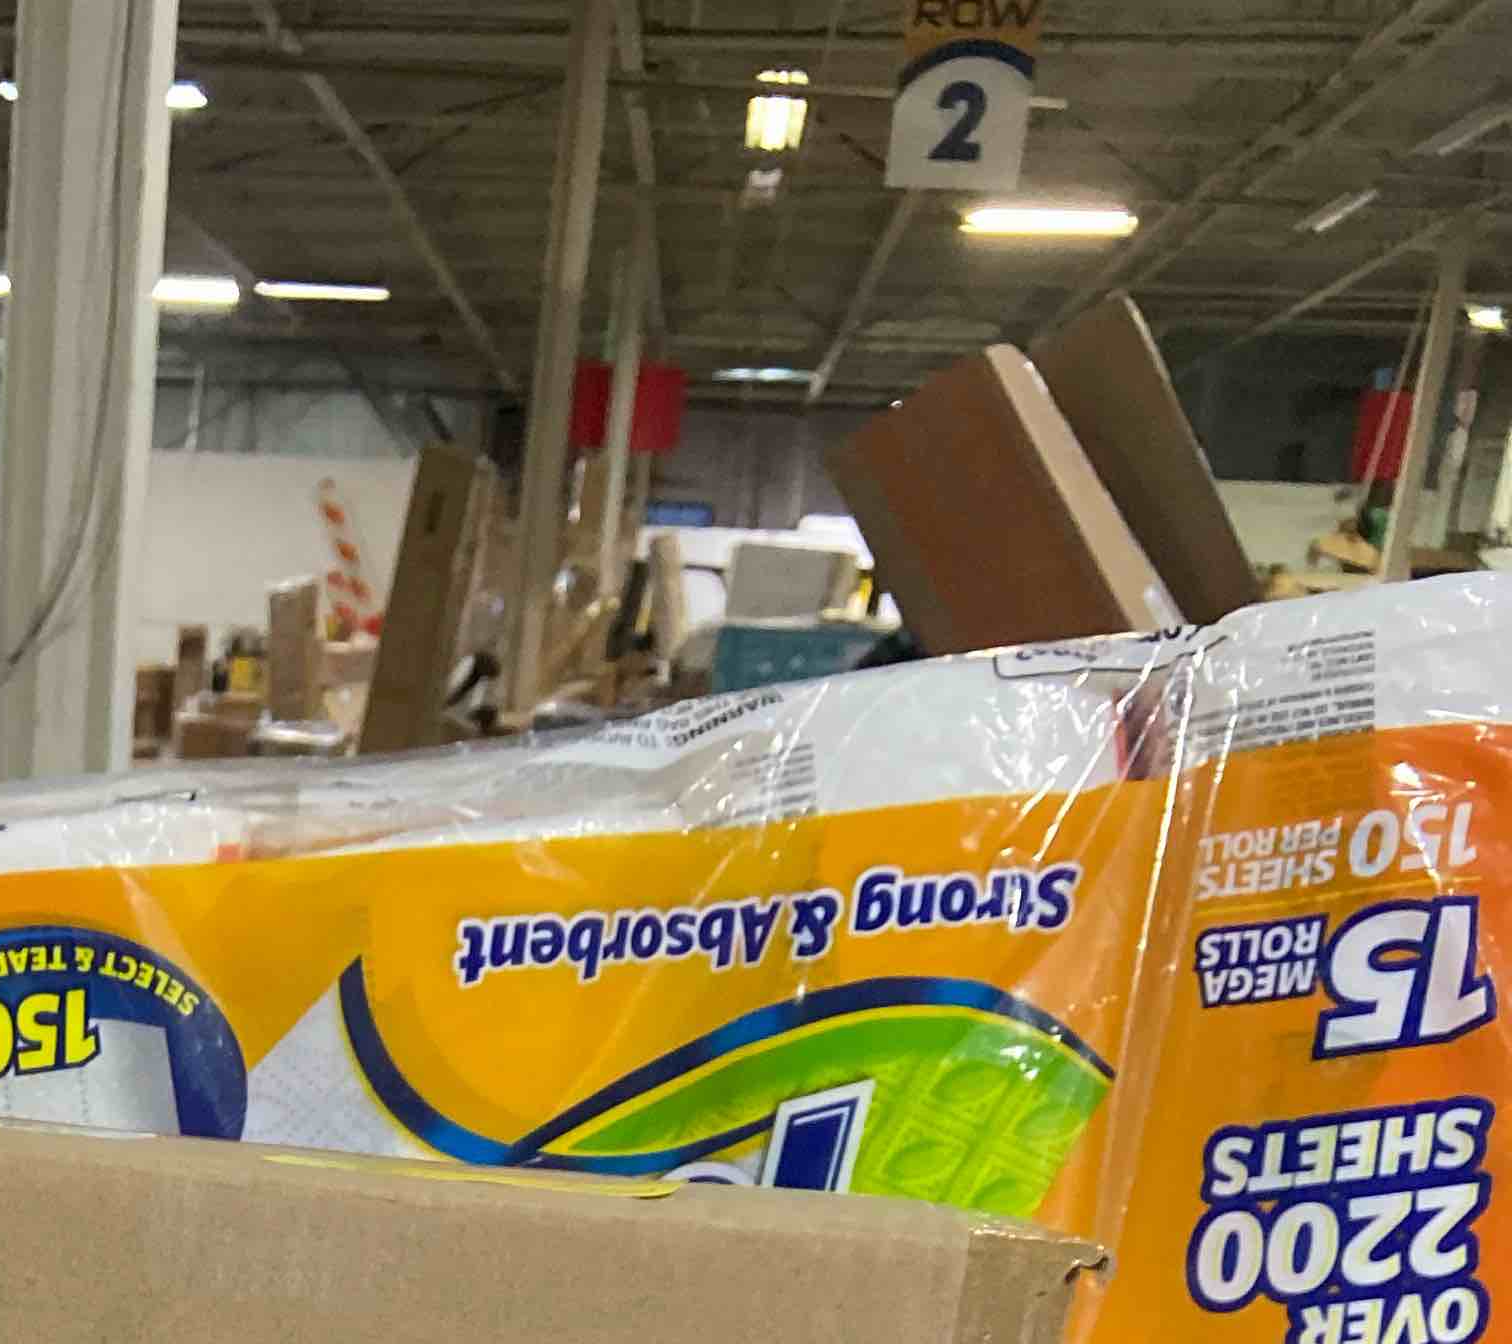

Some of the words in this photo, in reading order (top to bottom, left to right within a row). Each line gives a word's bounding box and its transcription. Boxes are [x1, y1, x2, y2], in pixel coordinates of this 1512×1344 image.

[928, 80, 987, 163] 2
[1198, 828, 1280, 860] ROLL
[1282, 815, 1339, 848] PER
[1349, 801, 1477, 879] 150
[856, 865, 1078, 932] Strong
[1195, 849, 1339, 900] SHEETS
[459, 904, 781, 983] Absorbent
[793, 892, 836, 956] &
[1199, 922, 1320, 969] ROLLS
[74, 947, 94, 970] &
[99, 951, 200, 1016] SELECT
[1202, 959, 1316, 1000] MEGA
[1319, 901, 1492, 1056] 15
[1211, 1107, 1483, 1197] SHEETS
[1195, 1182, 1478, 1306] 2200
